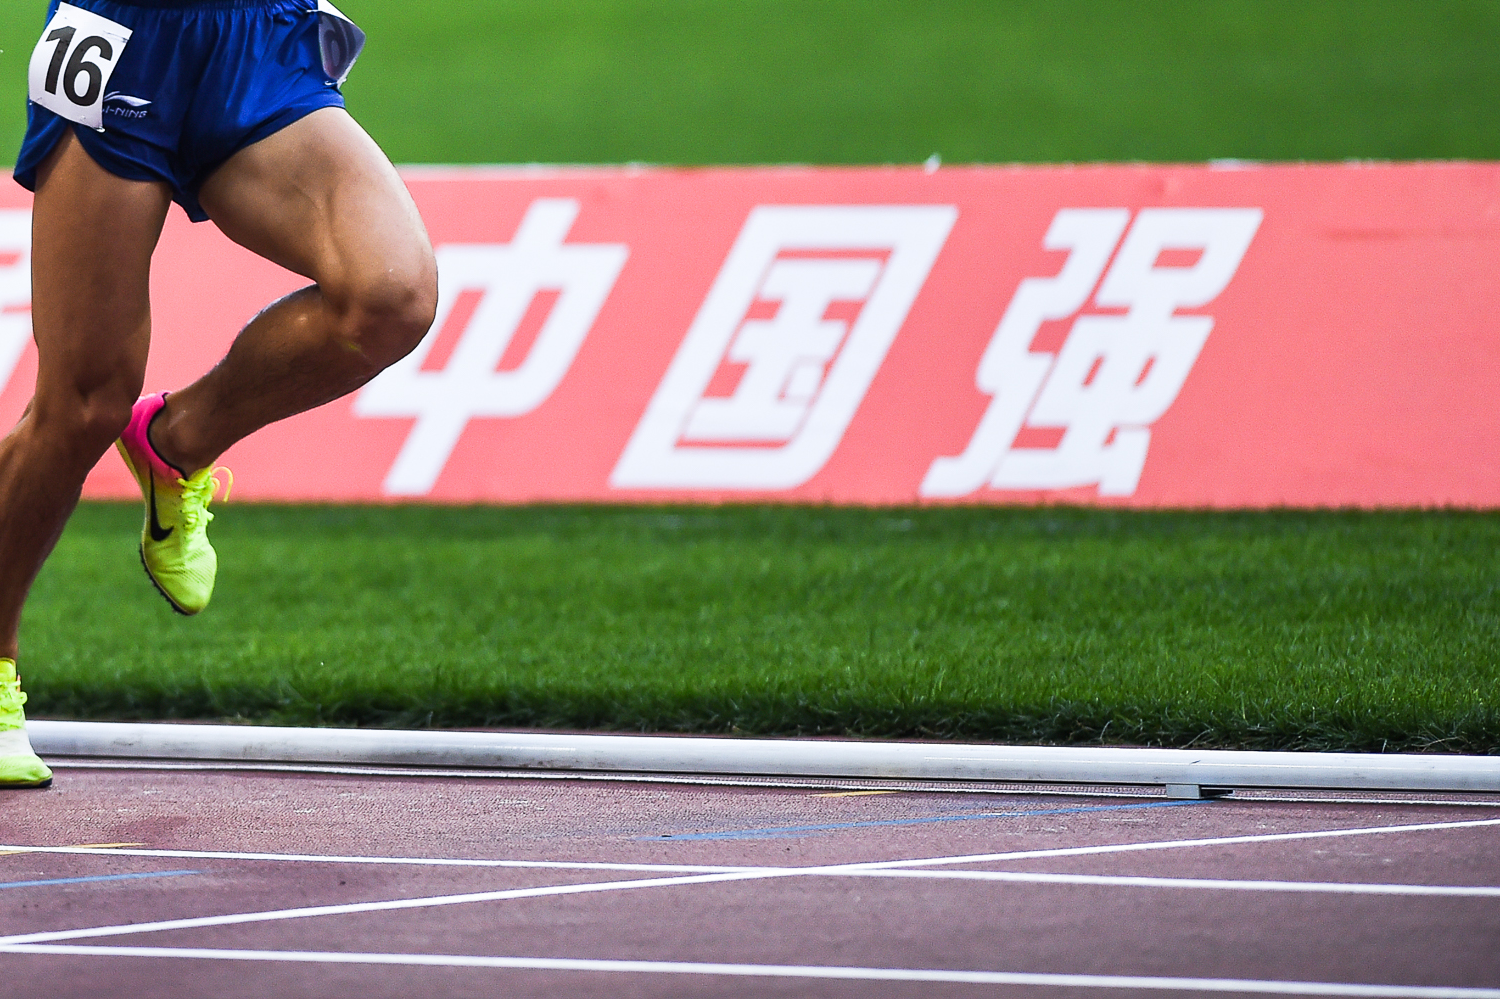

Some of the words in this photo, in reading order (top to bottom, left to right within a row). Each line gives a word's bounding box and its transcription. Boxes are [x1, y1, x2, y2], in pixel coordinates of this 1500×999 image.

[44, 25, 113, 107] 16
[102, 105, 148, 119] I-NING
[351, 199, 1264, 497] 中国强
